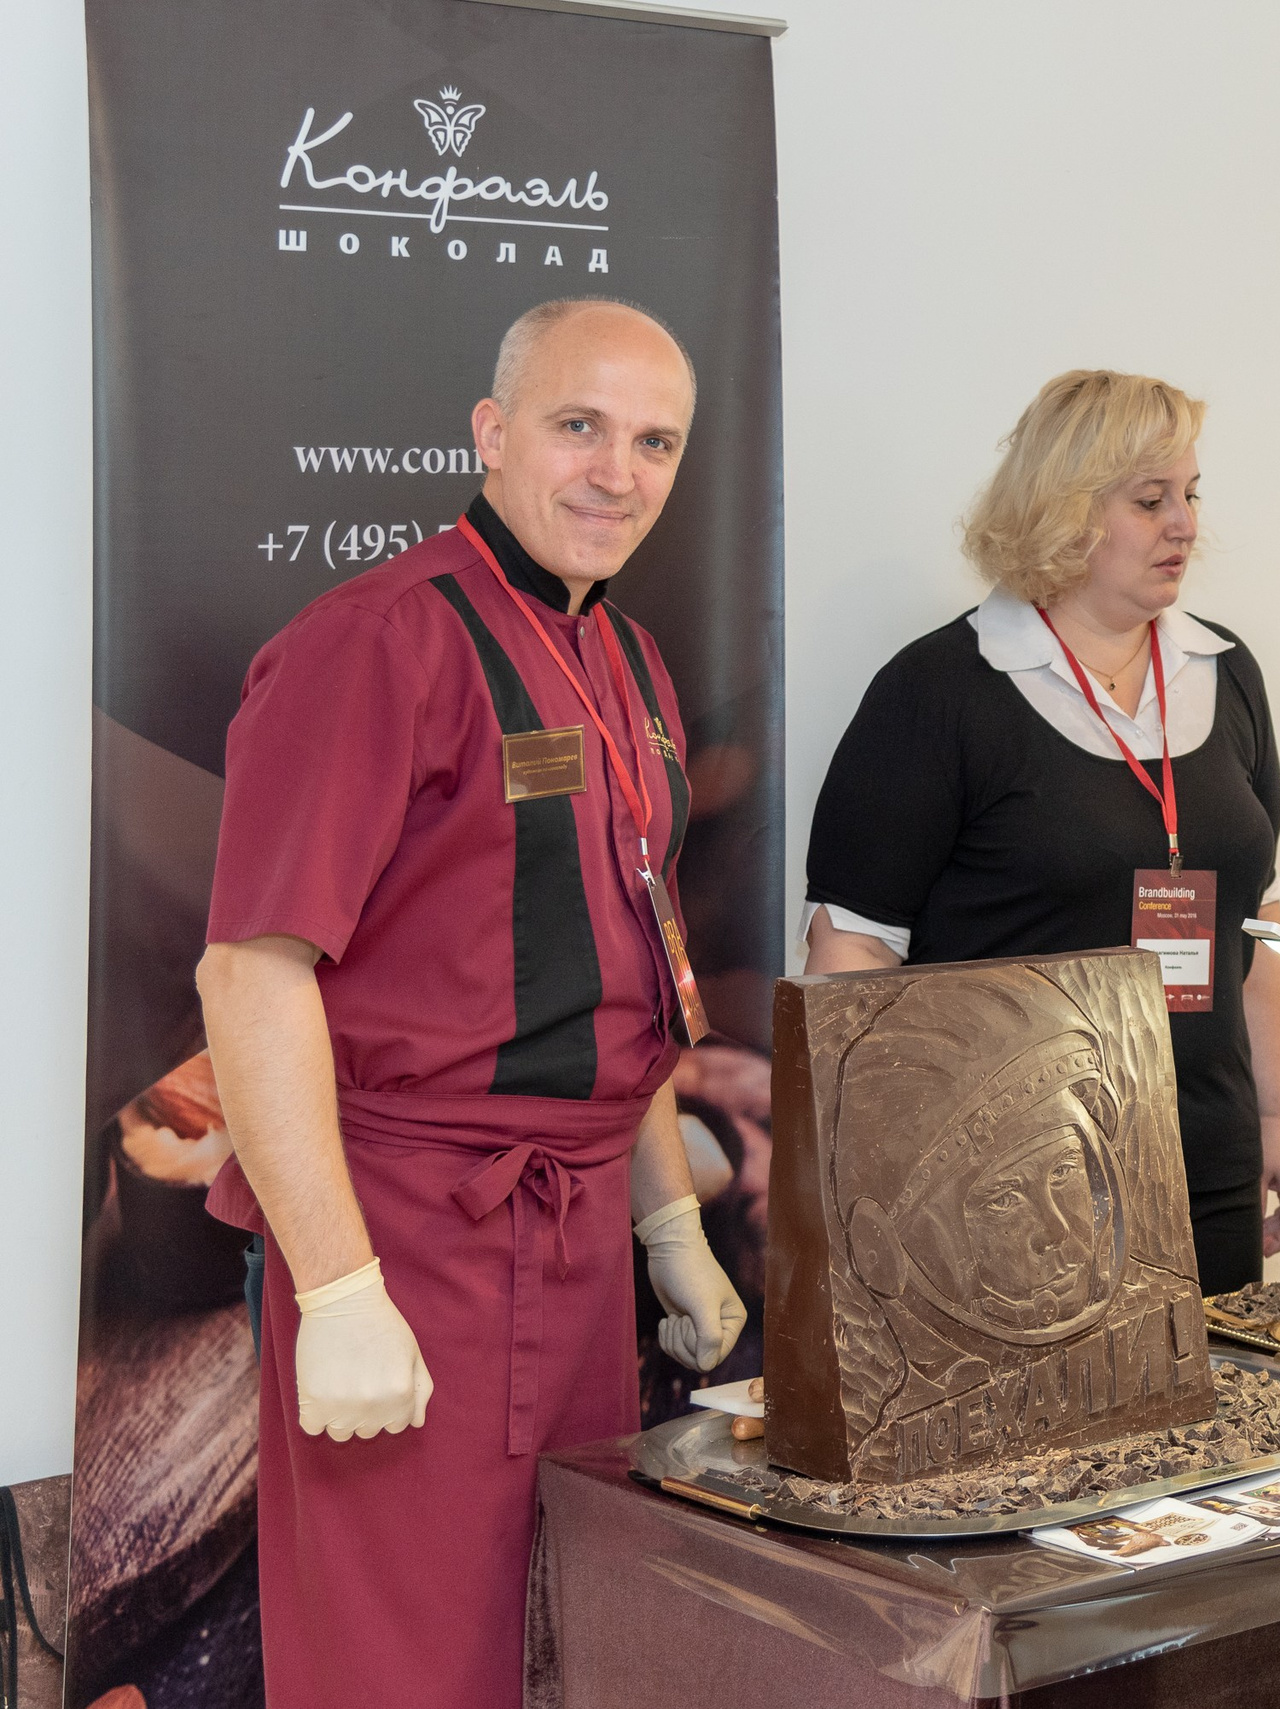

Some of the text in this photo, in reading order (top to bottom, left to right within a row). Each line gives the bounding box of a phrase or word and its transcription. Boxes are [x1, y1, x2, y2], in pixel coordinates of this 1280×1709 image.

[279, 107, 609, 234] Конфаэль
[278, 229, 609, 273] ШОКОЛАД
[257, 525, 310, 562] +7
[1138, 886, 1195, 901] Brandbuilding
[1138, 901, 1172, 911] Conference
[898, 1290, 1197, 1475] ПОЕХАЛИ!
